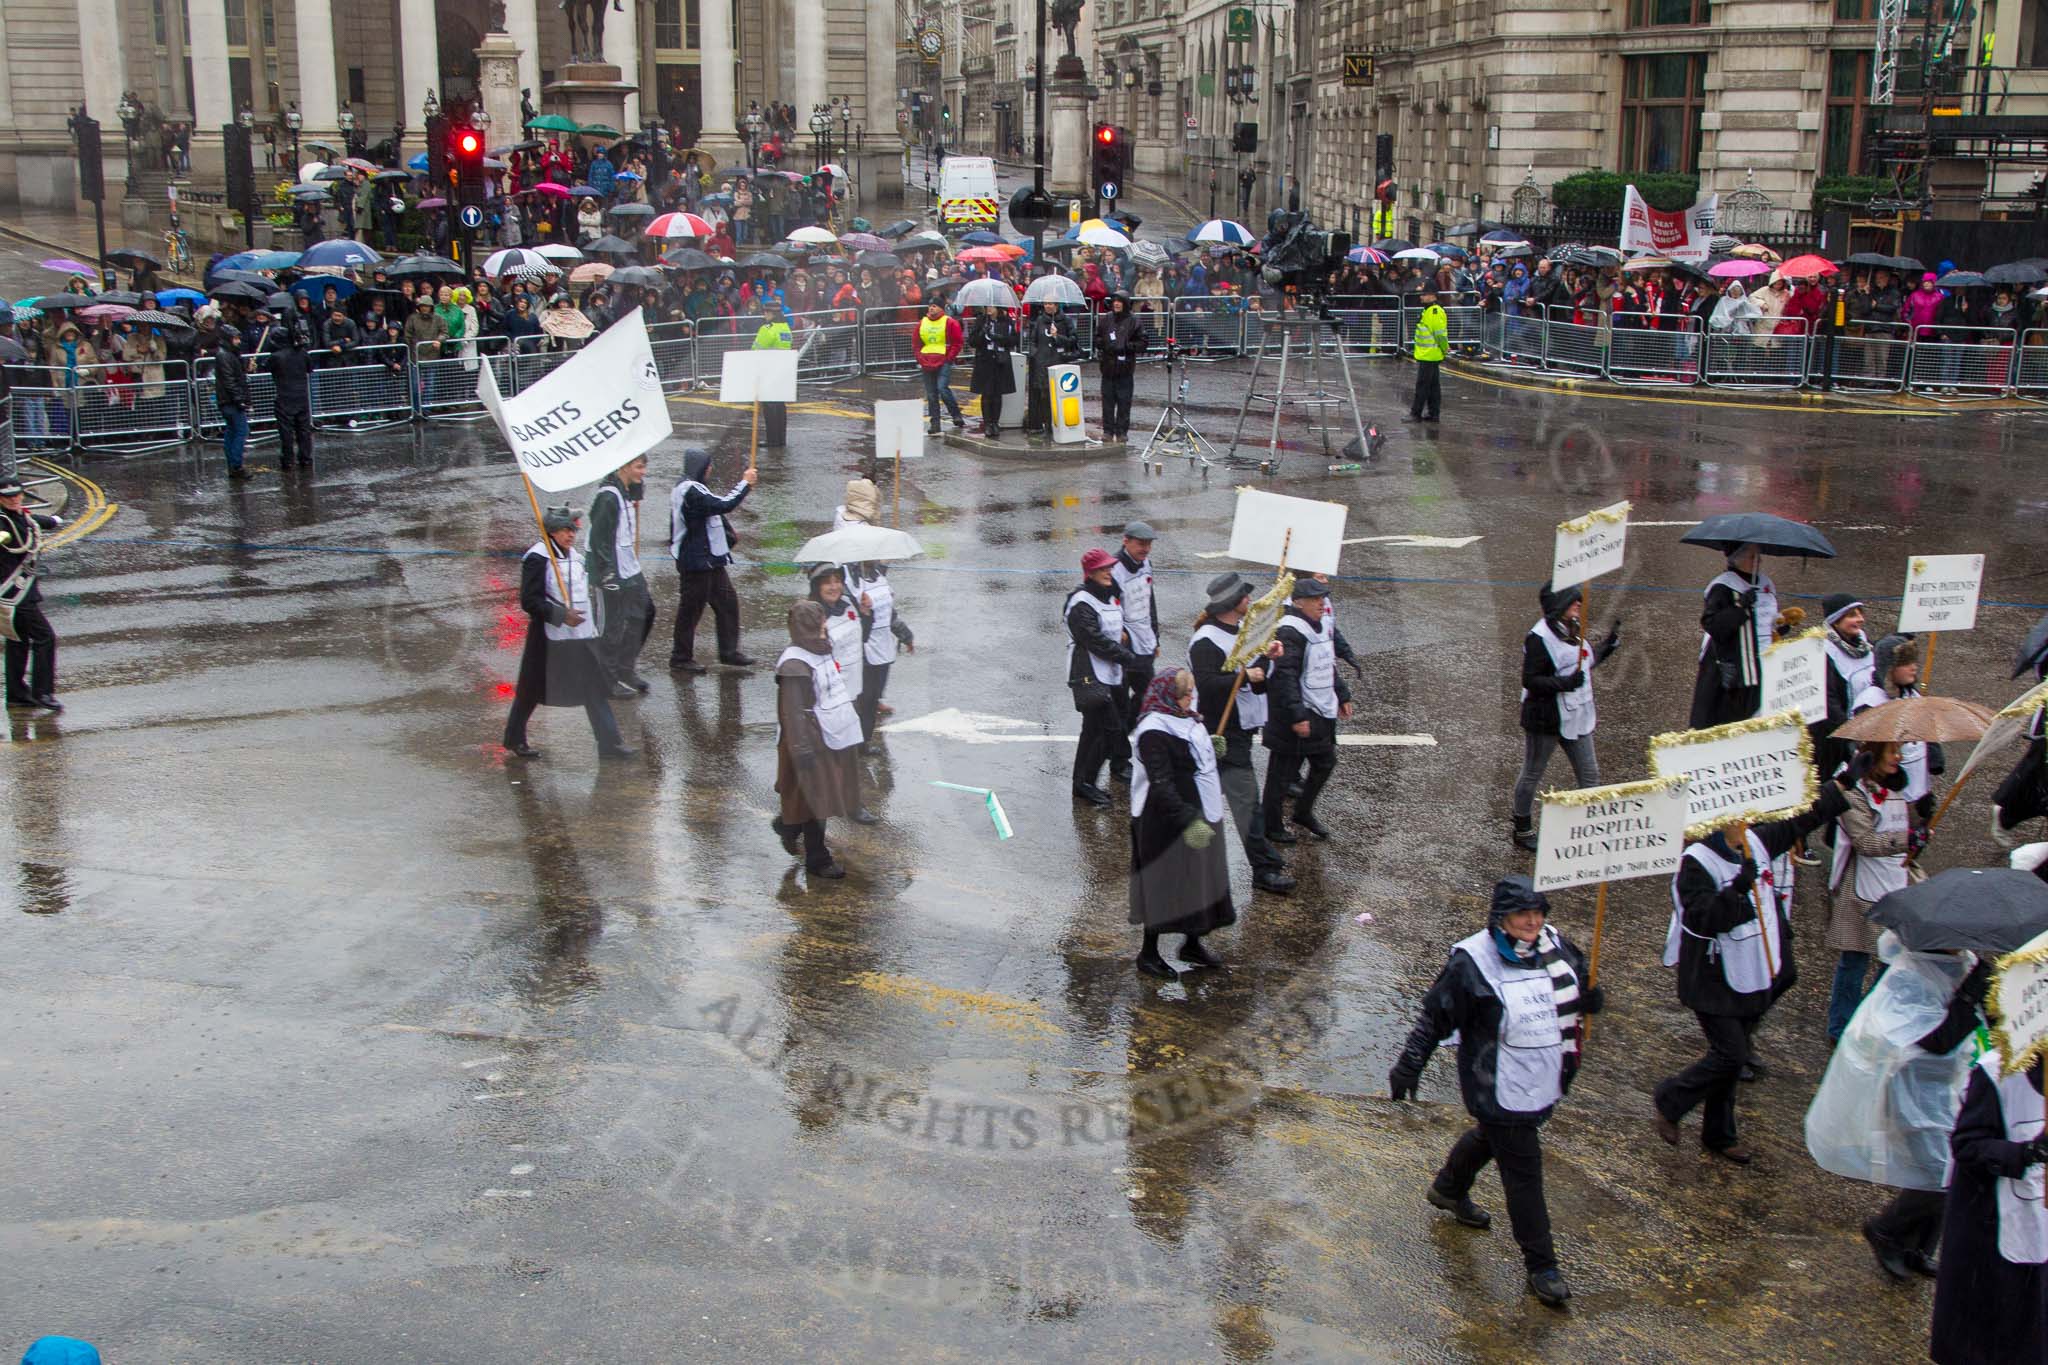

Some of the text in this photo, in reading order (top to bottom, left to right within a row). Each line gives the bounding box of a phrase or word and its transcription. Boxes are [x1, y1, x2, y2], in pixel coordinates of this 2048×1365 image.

[1653, 226, 1680, 236] BOWEL
[1655, 220, 1674, 228] BEAT
[511, 400, 581, 442] BARTS
[1721, 748, 1799, 775] PATIENTS
[1687, 767, 1784, 799] NEWSPAPER
[1586, 798, 1645, 819] BART'S
[1689, 783, 1787, 814] DELIVERIES
[1570, 816, 1654, 840] HOSPITAL
[1554, 832, 1668, 860] VOLUNTEERS
[1539, 874, 1571, 887] Please
